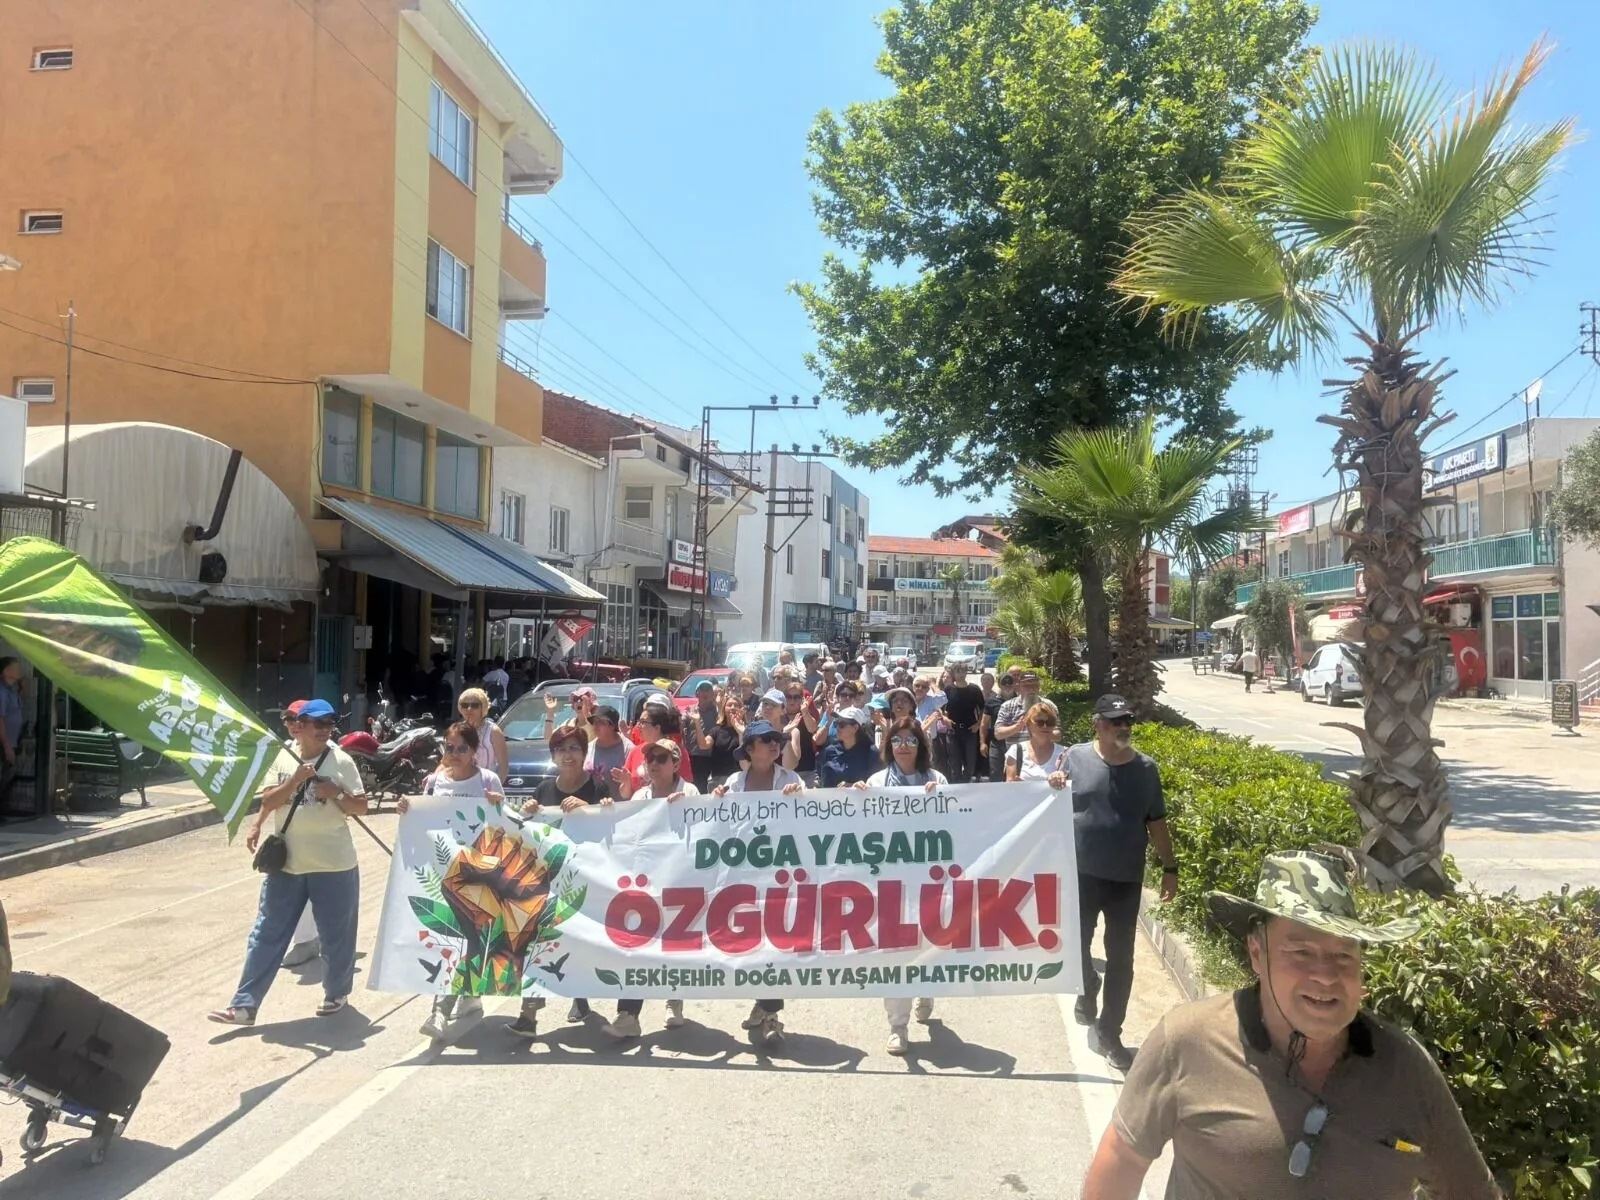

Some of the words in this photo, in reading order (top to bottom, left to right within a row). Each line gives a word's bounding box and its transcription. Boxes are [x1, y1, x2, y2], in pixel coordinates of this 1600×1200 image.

[683, 800, 751, 823] mutlu
[758, 800, 788, 820] bir
[795, 797, 856, 820] hayat
[695, 825, 801, 869] DOĞA
[605, 864, 1061, 954] ÖZGÜRLÜK!
[624, 964, 725, 991] ESKİŞEHİR
[734, 963, 792, 986] DOĞA
[796, 968, 822, 986] VE
[827, 965, 902, 990] YAŞAM
